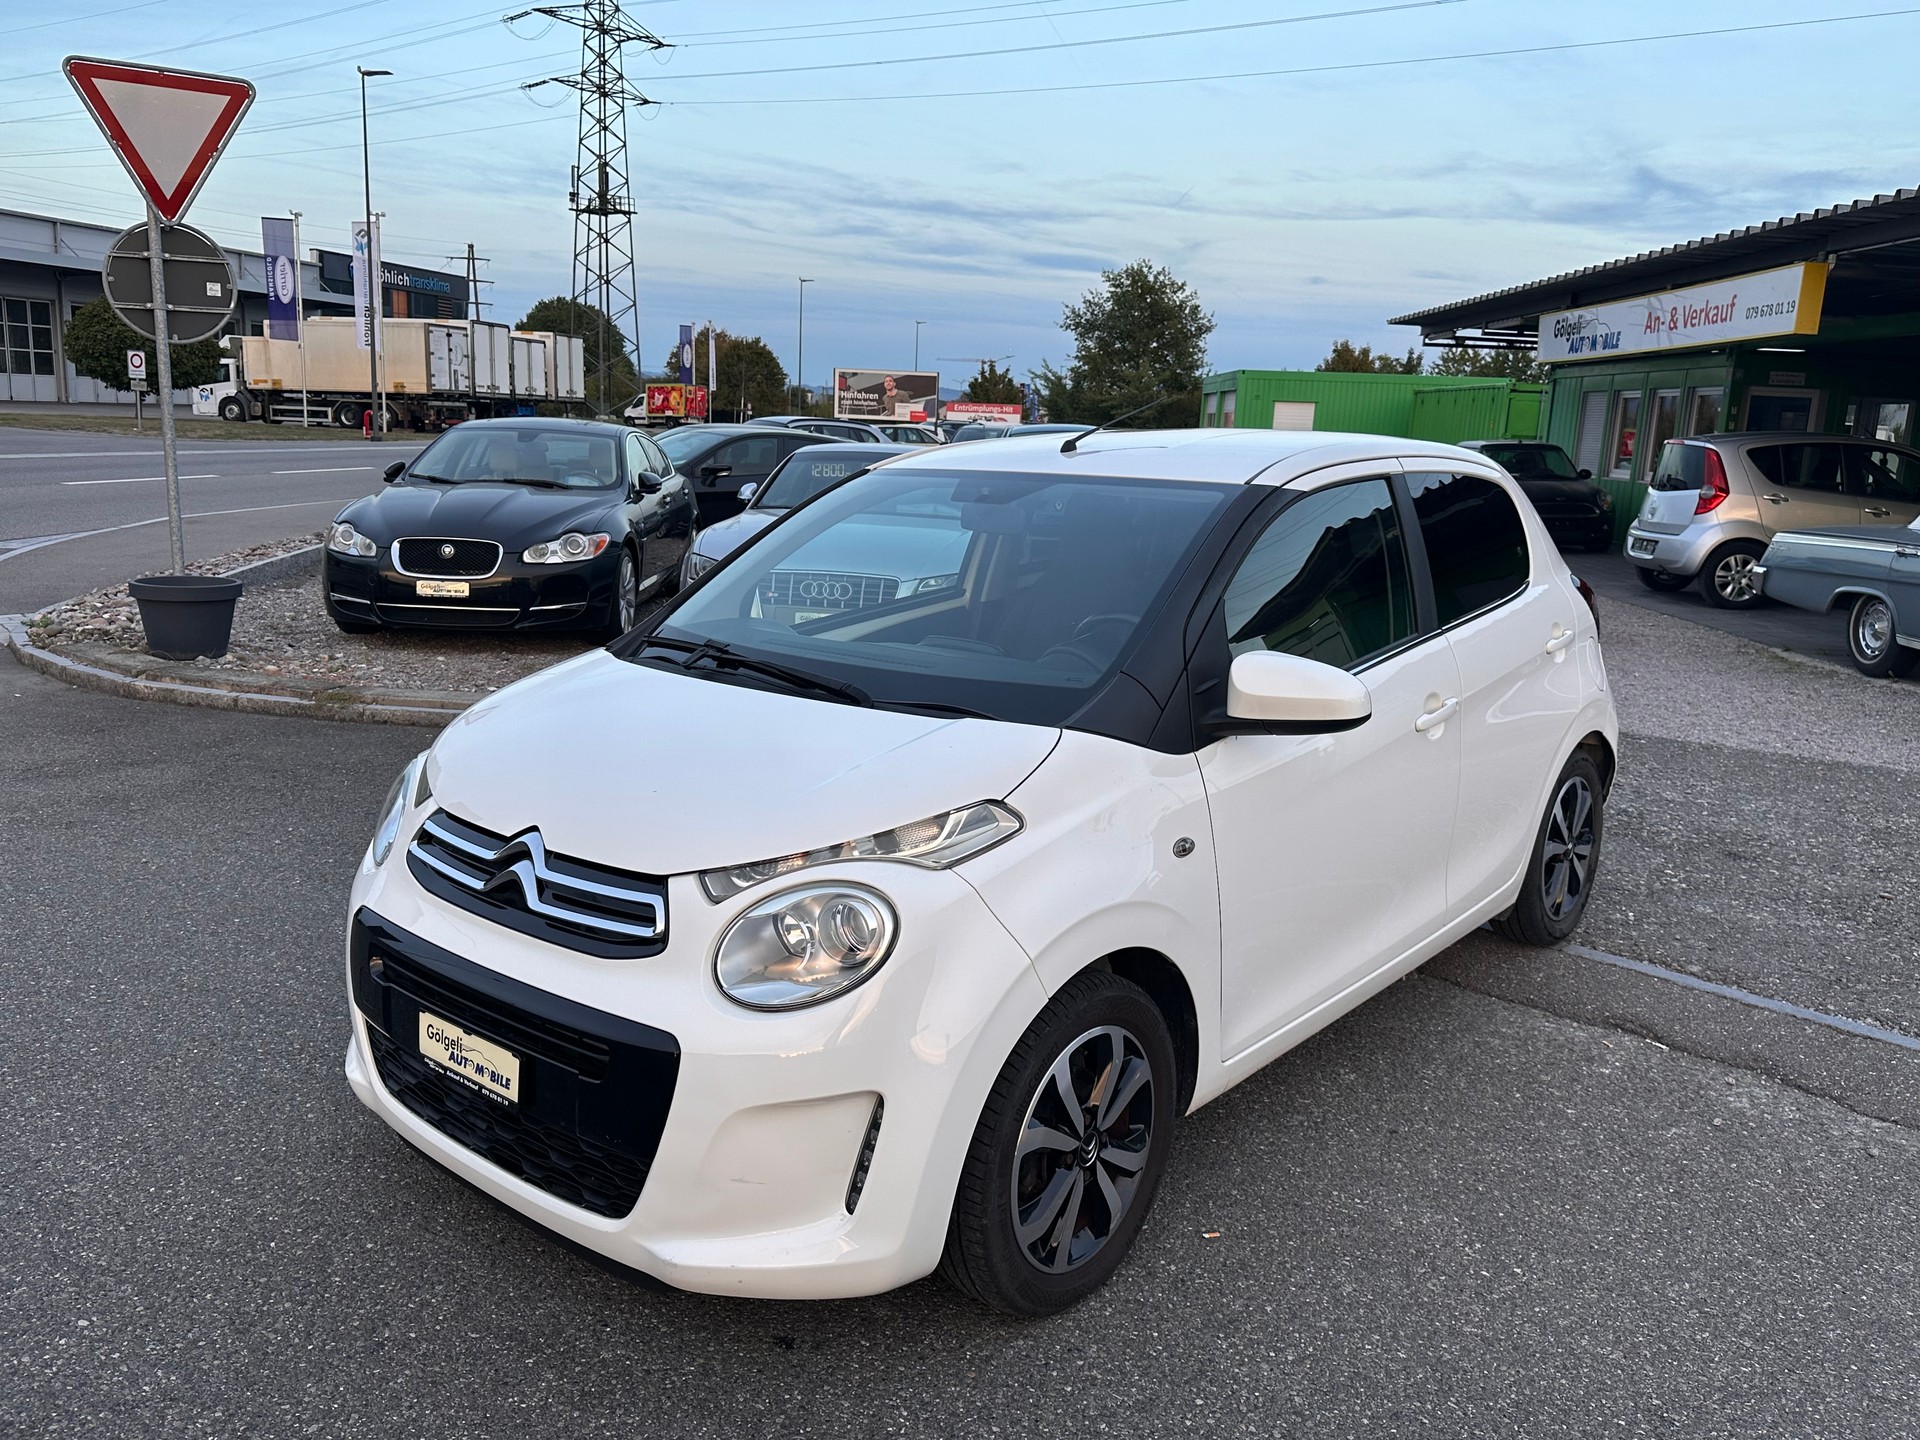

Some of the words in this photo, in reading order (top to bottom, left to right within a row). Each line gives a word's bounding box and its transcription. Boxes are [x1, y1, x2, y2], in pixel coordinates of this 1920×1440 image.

[1643, 311, 1666, 335] An-
[1668, 306, 1679, 331] &
[1682, 294, 1738, 329] Verkauf
[1745, 306, 1759, 320] 079
[1760, 303, 1774, 317] 678
[1774, 302, 1785, 316] 01
[1785, 300, 1796, 314] 19
[1553, 314, 1583, 343] Gölgeli
[1568, 331, 1622, 354] AUTOMOBILE
[840, 390, 879, 400] Hinfahren
[426, 1023, 463, 1054] Gölgeli
[448, 1050, 512, 1091] AUTOMOBILE
